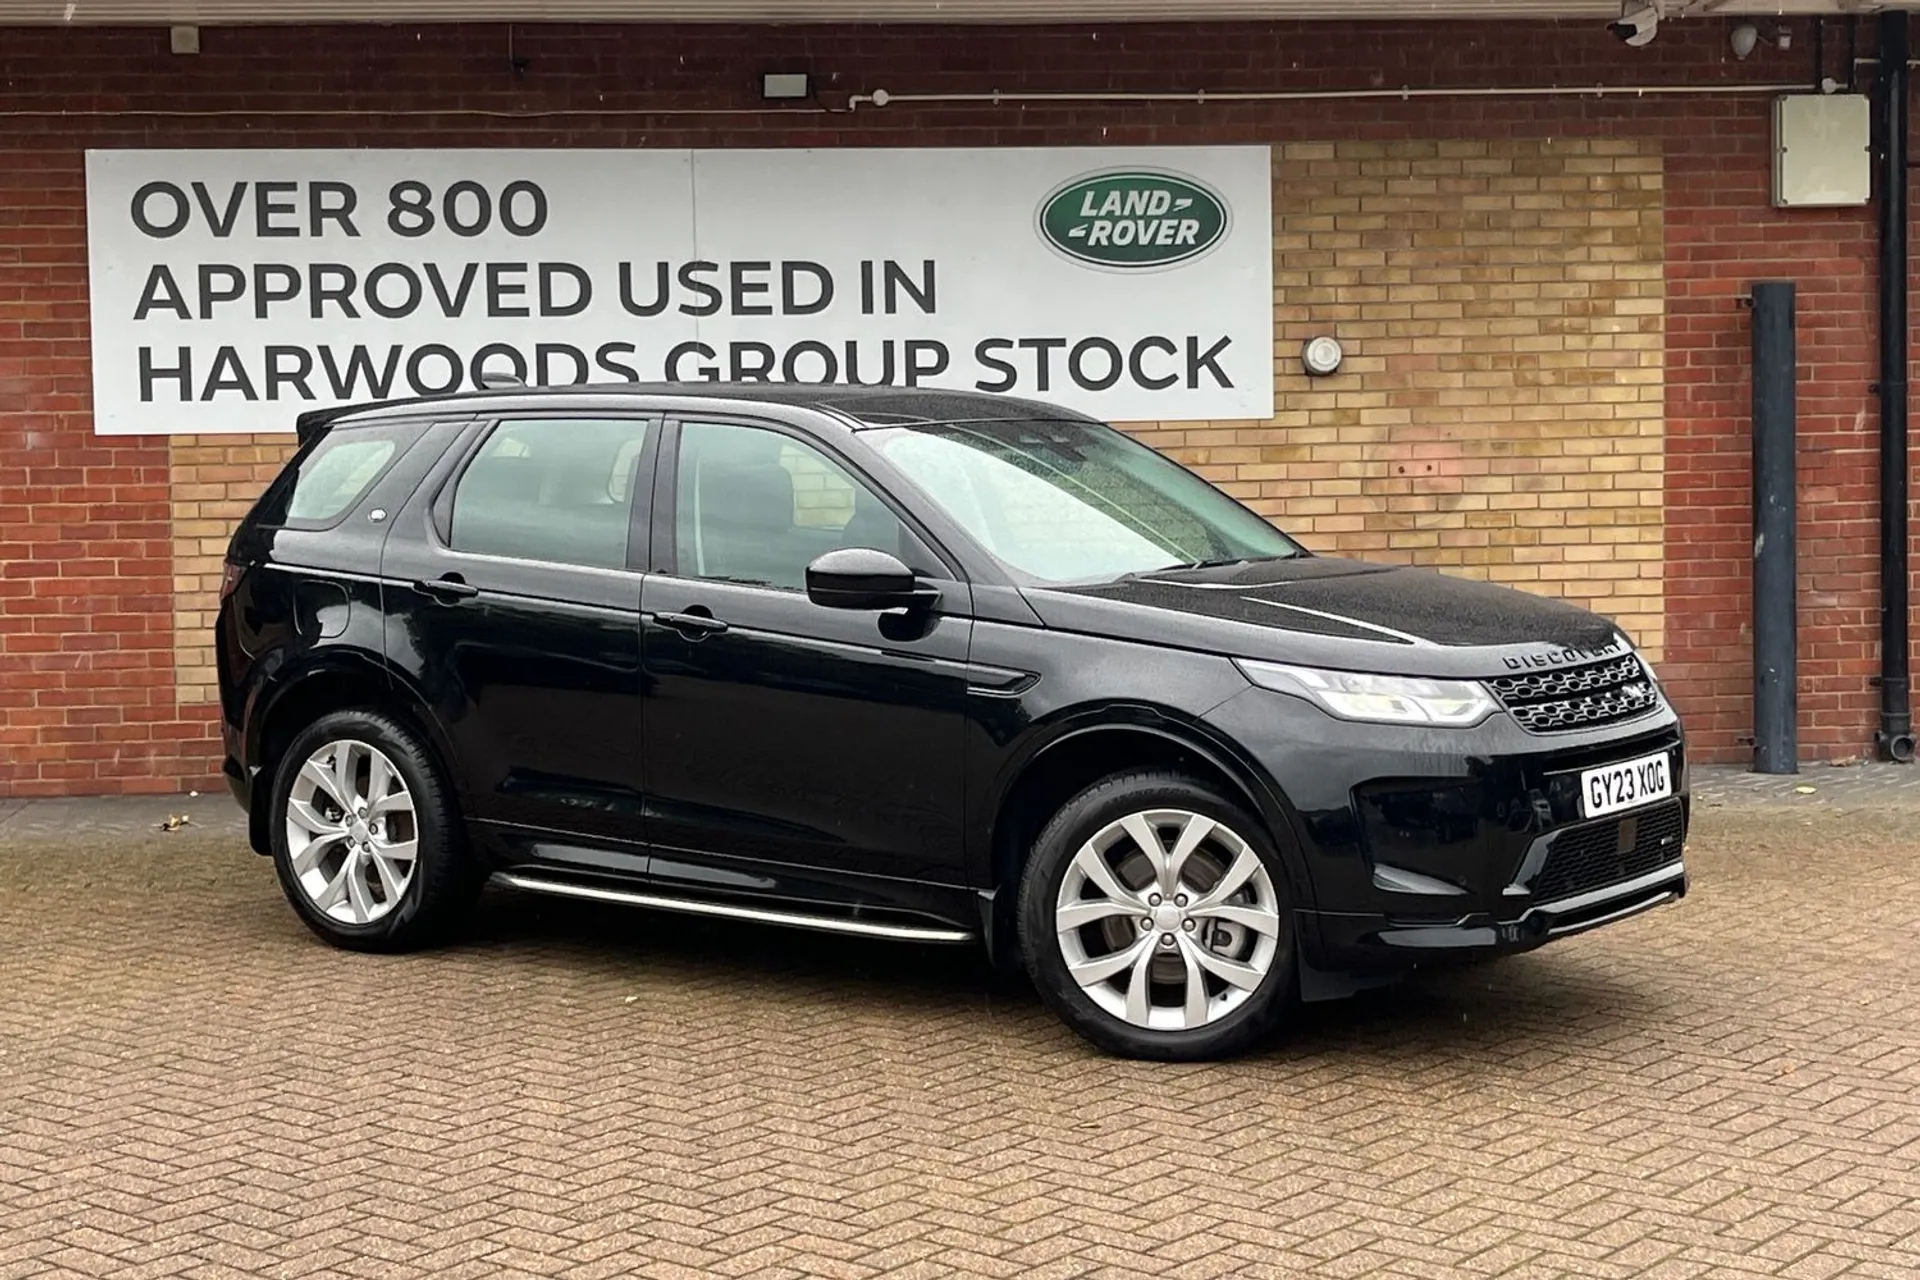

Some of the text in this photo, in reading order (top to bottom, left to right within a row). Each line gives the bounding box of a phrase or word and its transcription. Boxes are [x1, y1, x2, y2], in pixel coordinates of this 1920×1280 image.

[131, 180, 548, 238] OVER 800
[1080, 190, 1172, 217] LAND
[1087, 219, 1200, 246] ROVER
[133, 260, 936, 319] APPROVED USED IN
[139, 335, 1235, 402] HARWOODS GROUP STOCK
[1590, 760, 1664, 808] GY23 XOG
